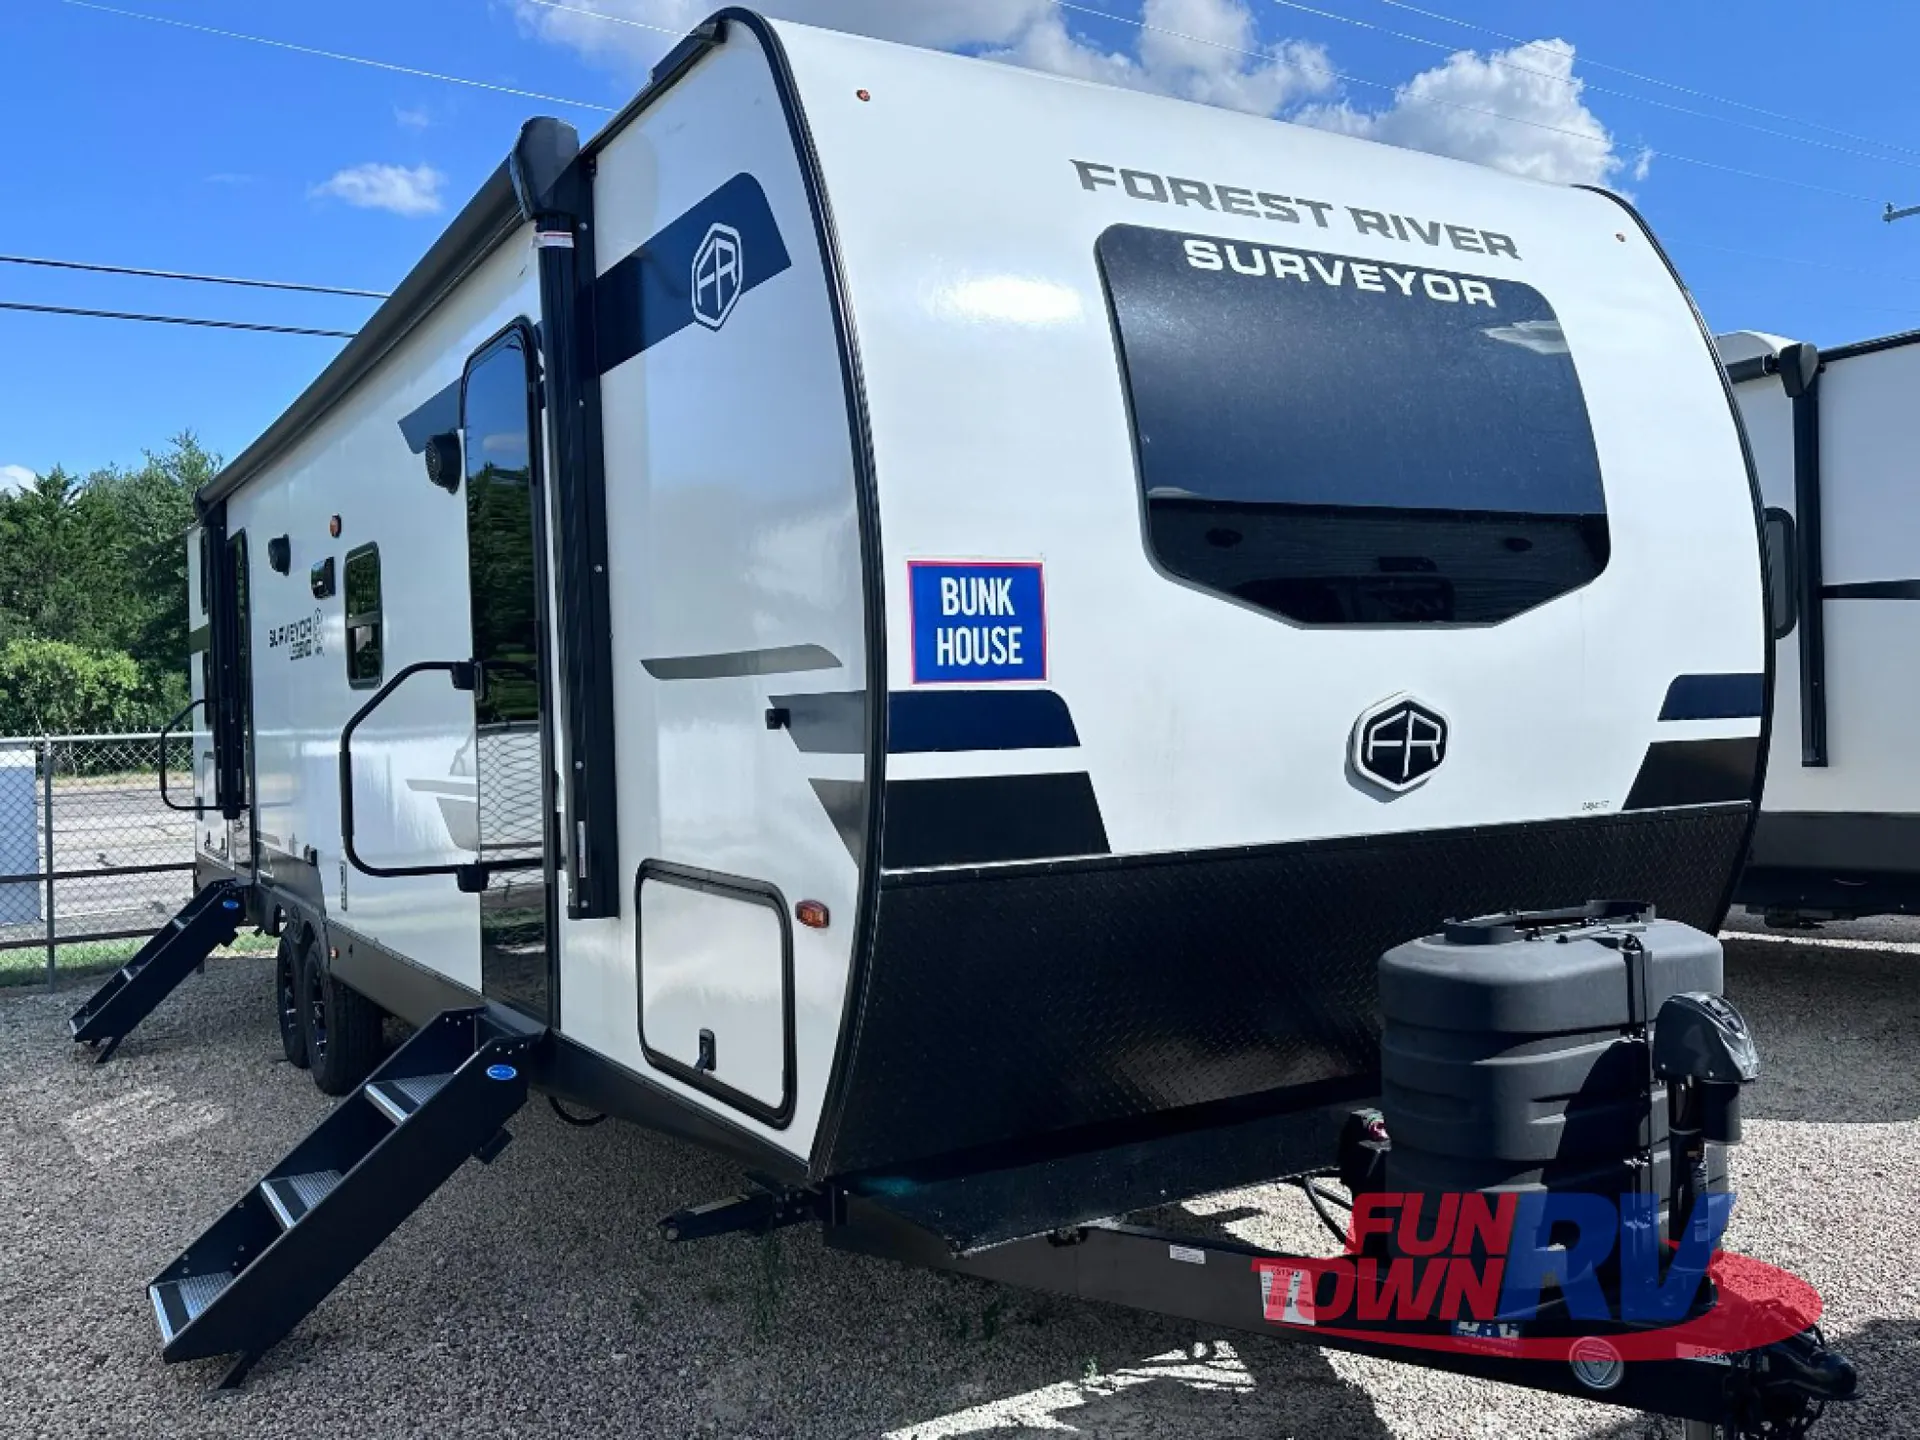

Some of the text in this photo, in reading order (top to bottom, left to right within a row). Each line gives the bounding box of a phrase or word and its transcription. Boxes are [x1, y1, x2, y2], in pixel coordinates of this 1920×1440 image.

[1069, 158, 1522, 261] FOREST RIVER
[1182, 239, 1497, 308] SURVEYOR
[940, 576, 1015, 616] BUNK
[936, 625, 1024, 667] HOUSE
